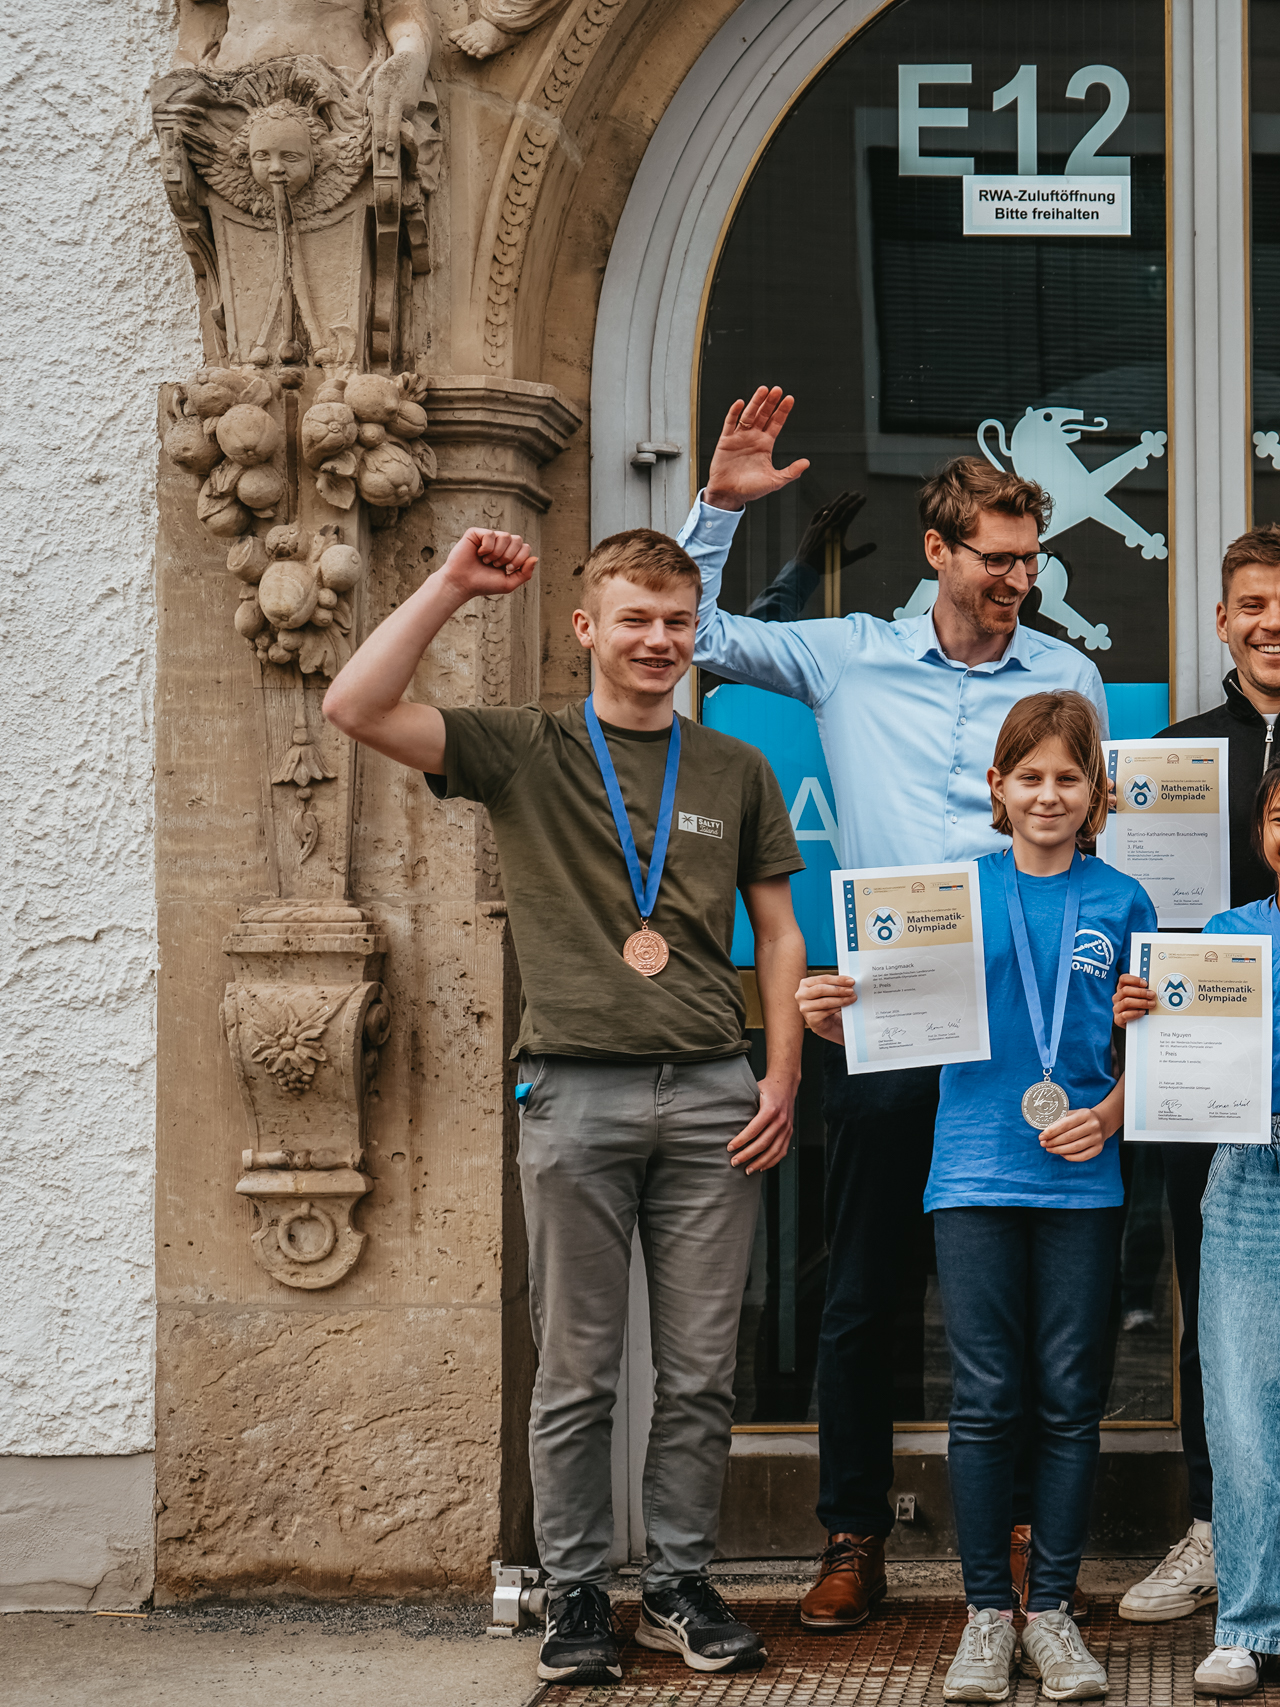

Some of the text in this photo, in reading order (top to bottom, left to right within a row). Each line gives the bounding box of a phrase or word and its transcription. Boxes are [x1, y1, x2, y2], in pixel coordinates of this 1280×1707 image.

[898, 63, 1131, 176] E12
[978, 189, 1116, 205] RWA-Zuluftöffnung
[994, 207, 1100, 220] Bitte freihalten
[1161, 784, 1213, 792] Mathematik-
[1161, 792, 1206, 802] Olympiade
[698, 818, 720, 829] SALTY
[907, 912, 965, 923] Mathematik-
[907, 922, 957, 934] Olympiade
[886, 963, 915, 971] Langmaack
[1071, 961, 1094, 975] O-Ni
[1198, 984, 1256, 993] Mathematik-
[1198, 993, 1248, 1004] Olympiade
